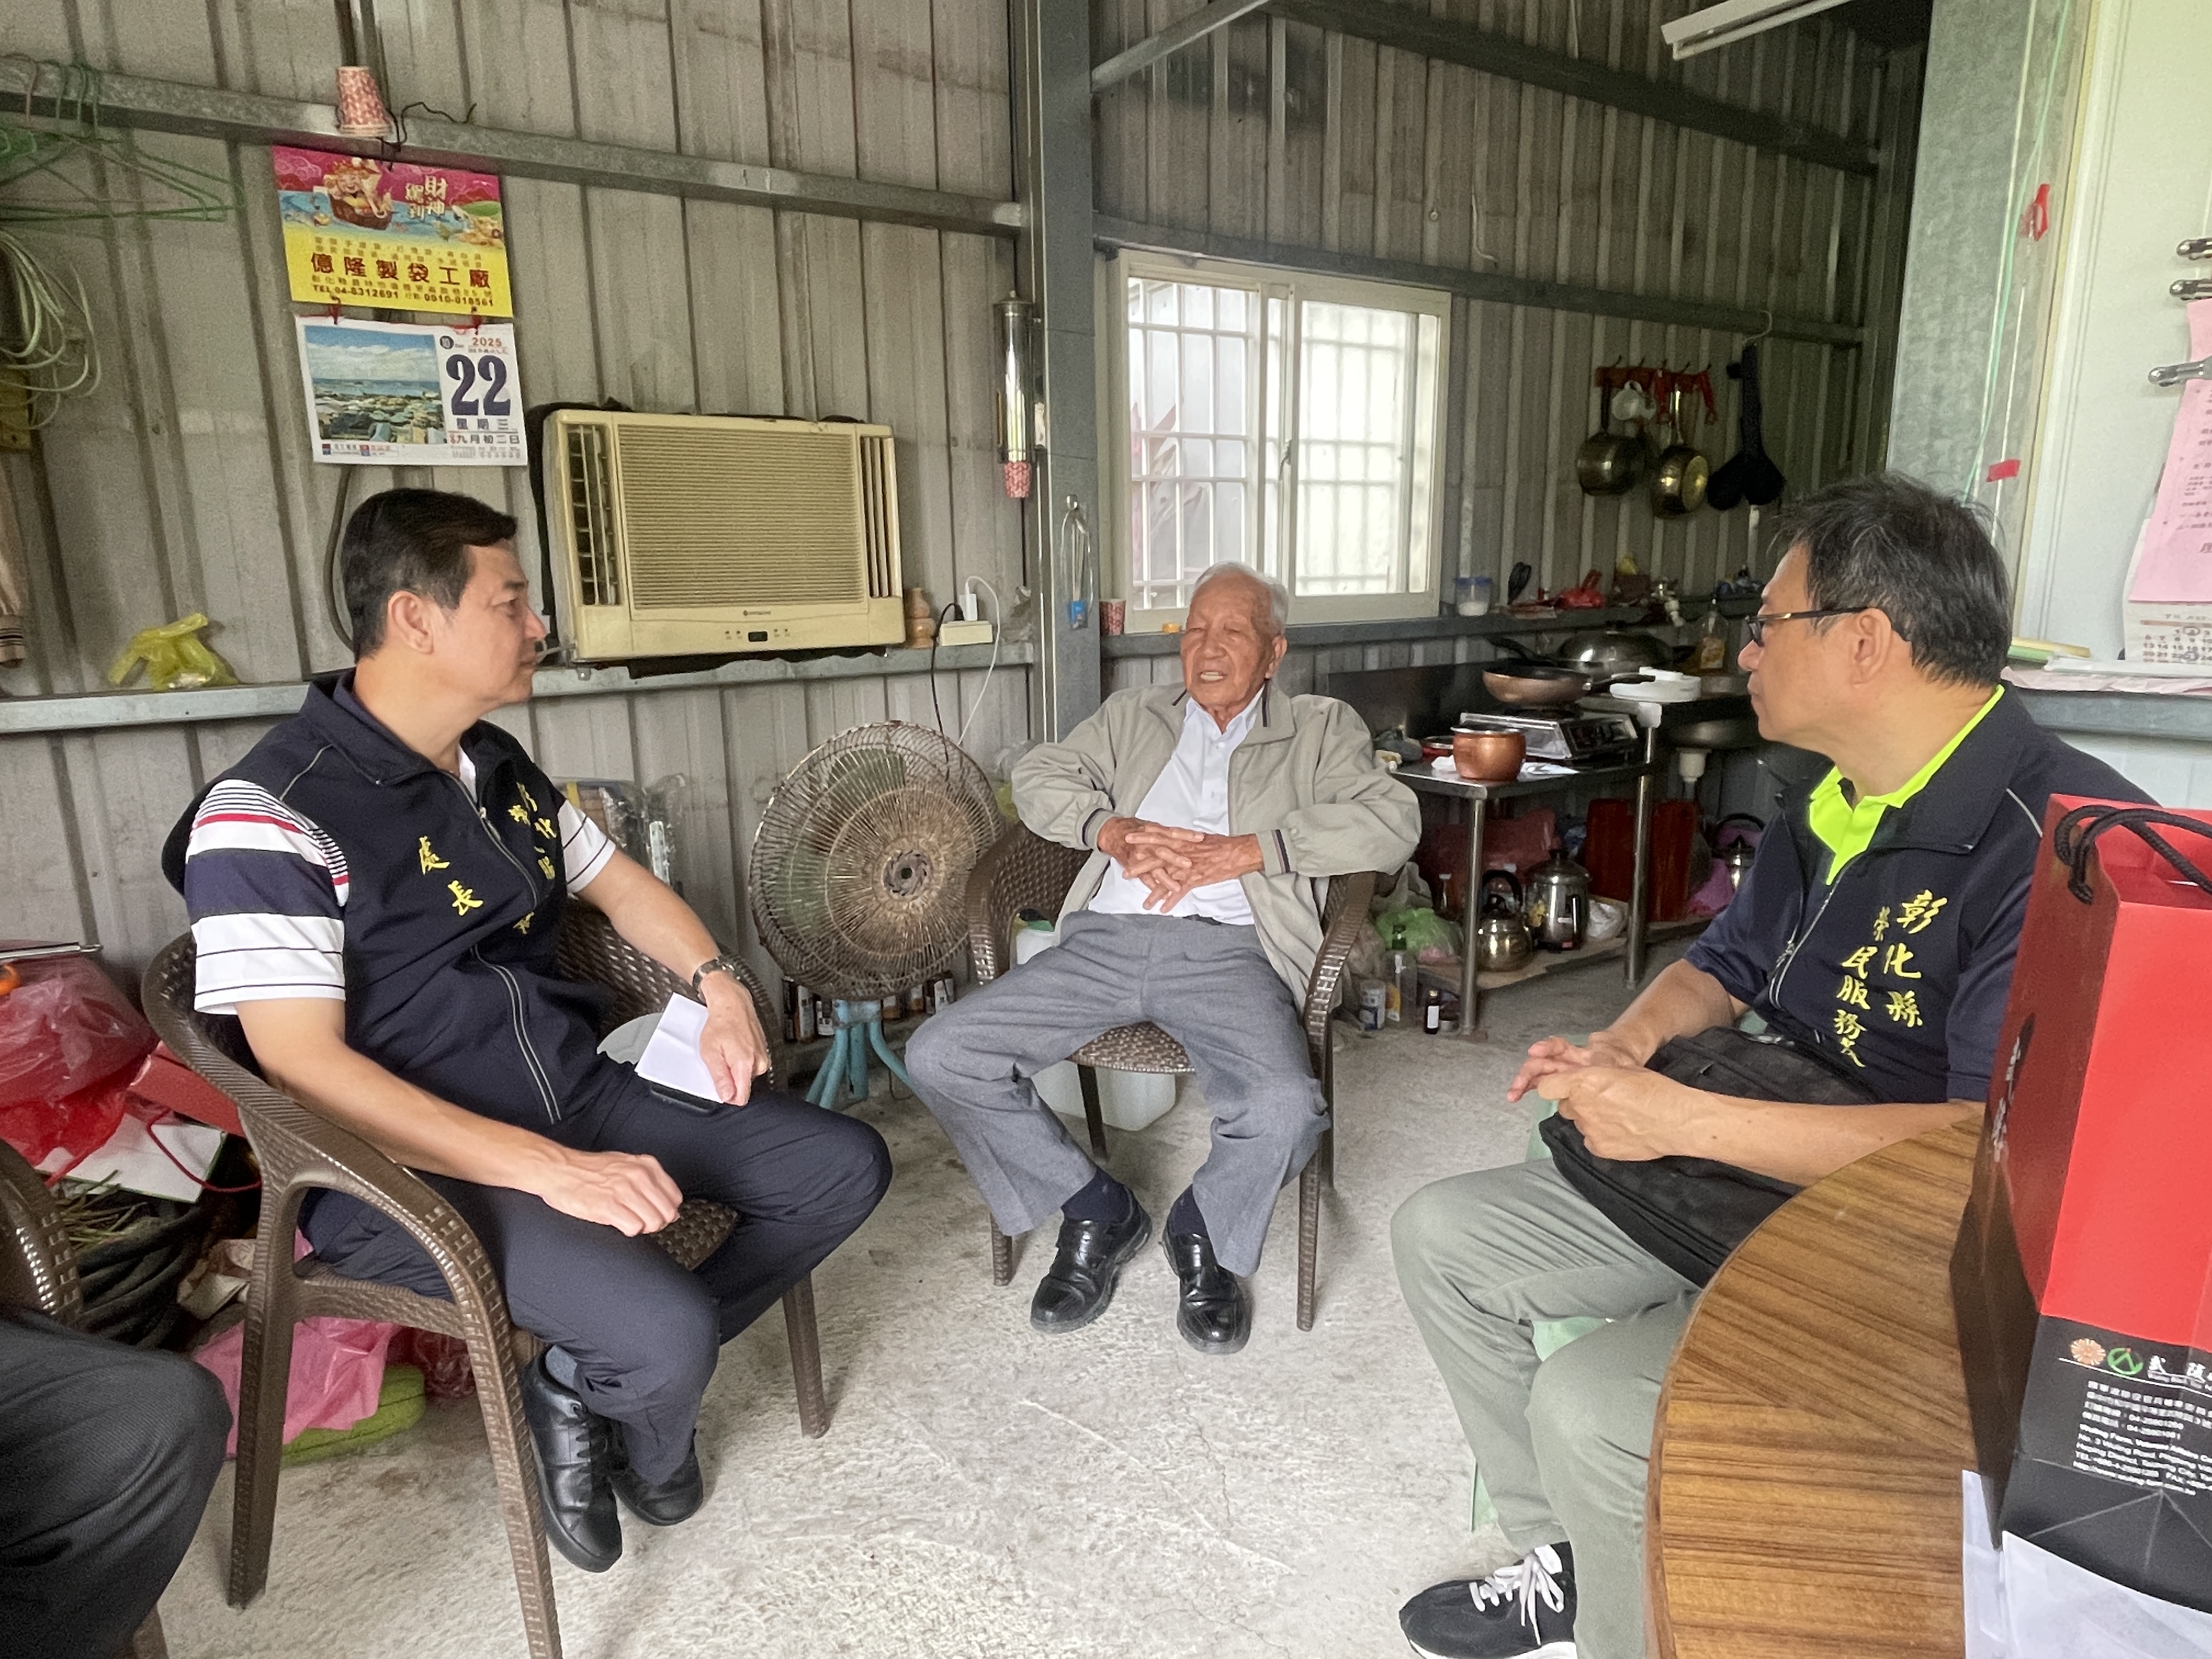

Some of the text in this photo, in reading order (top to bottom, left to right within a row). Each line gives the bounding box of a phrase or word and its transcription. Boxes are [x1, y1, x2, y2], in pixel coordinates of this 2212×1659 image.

[425, 174, 448, 216] 財神
[311, 252, 491, 289] 億隆製袋工廠
[472, 337, 503, 347] 2025
[445, 354, 511, 416] 22
[1884, 889, 1948, 1028] 彰化縣
